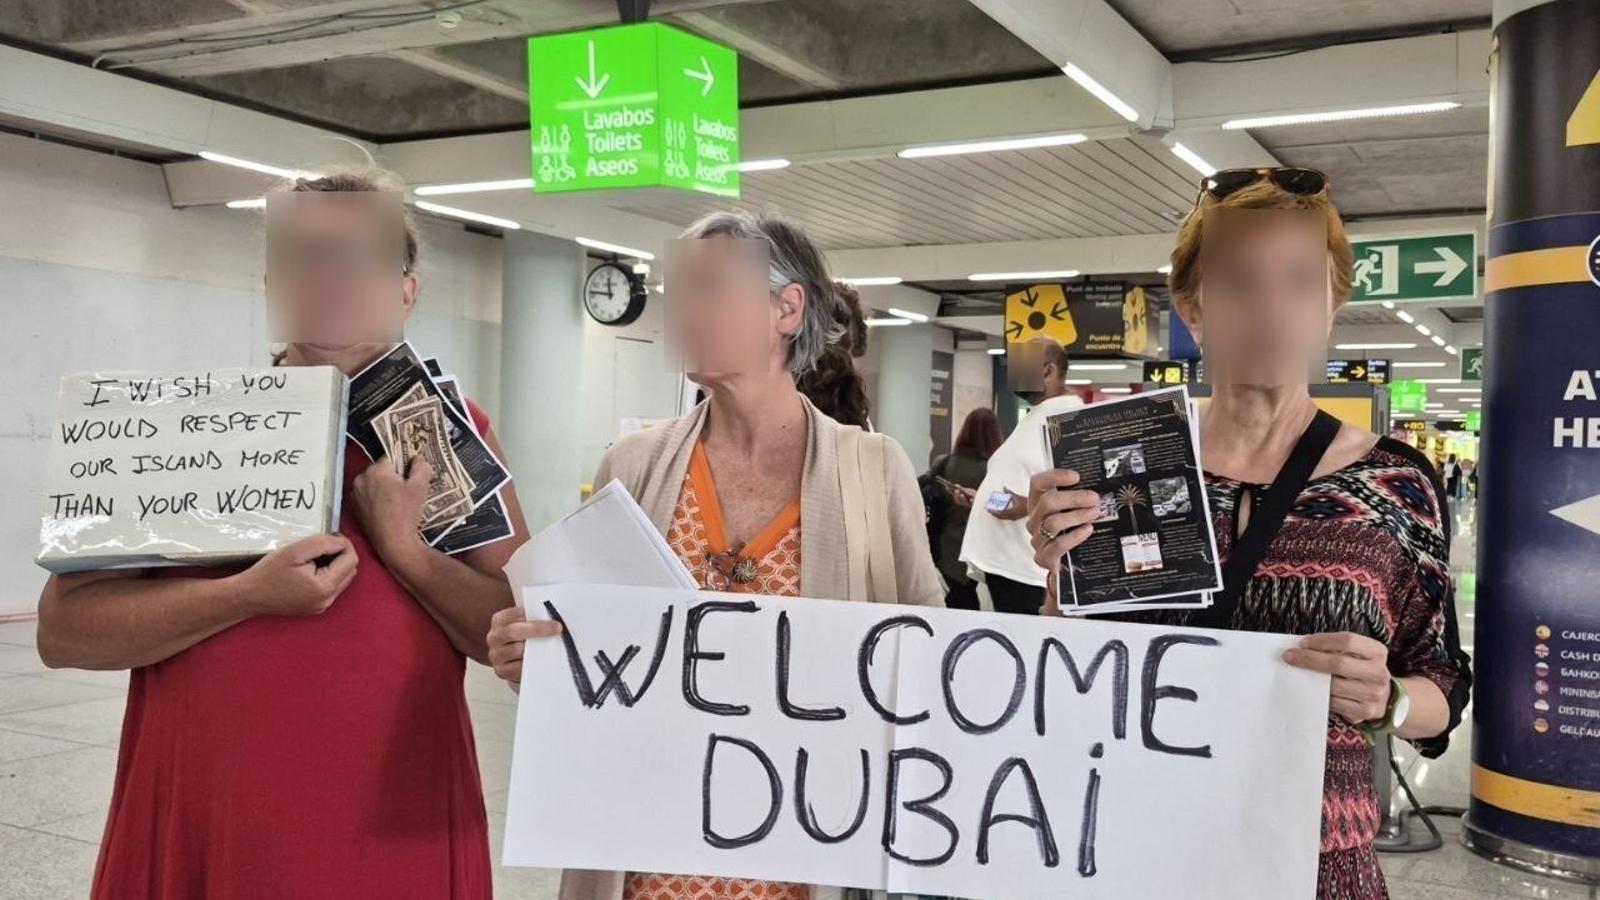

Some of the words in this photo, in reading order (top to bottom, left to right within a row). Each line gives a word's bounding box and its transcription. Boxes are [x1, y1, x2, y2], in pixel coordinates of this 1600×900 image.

[584, 107, 654, 131] Lavabos
[693, 112, 737, 142] Lavabos
[587, 131, 642, 154] Toilets
[695, 136, 730, 162] Toilets
[586, 157, 638, 177] Aseos
[695, 160, 727, 185] Aseos
[83, 379, 118, 407] I
[242, 373, 287, 394] YOU
[1563, 369, 1600, 401] A
[61, 418, 158, 444] WOULD
[181, 410, 302, 433] RESPECT
[70, 458, 118, 478] OUR
[131, 449, 223, 474] ISLAND
[240, 449, 304, 468] MORE
[49, 492, 114, 518] THAN
[137, 491, 198, 521] YOUR
[216, 481, 316, 514] WOMEN
[1560, 650, 1591, 661] CASH
[543, 600, 1222, 759] WELCOME
[1560, 667, 1600, 680] БАНКО
